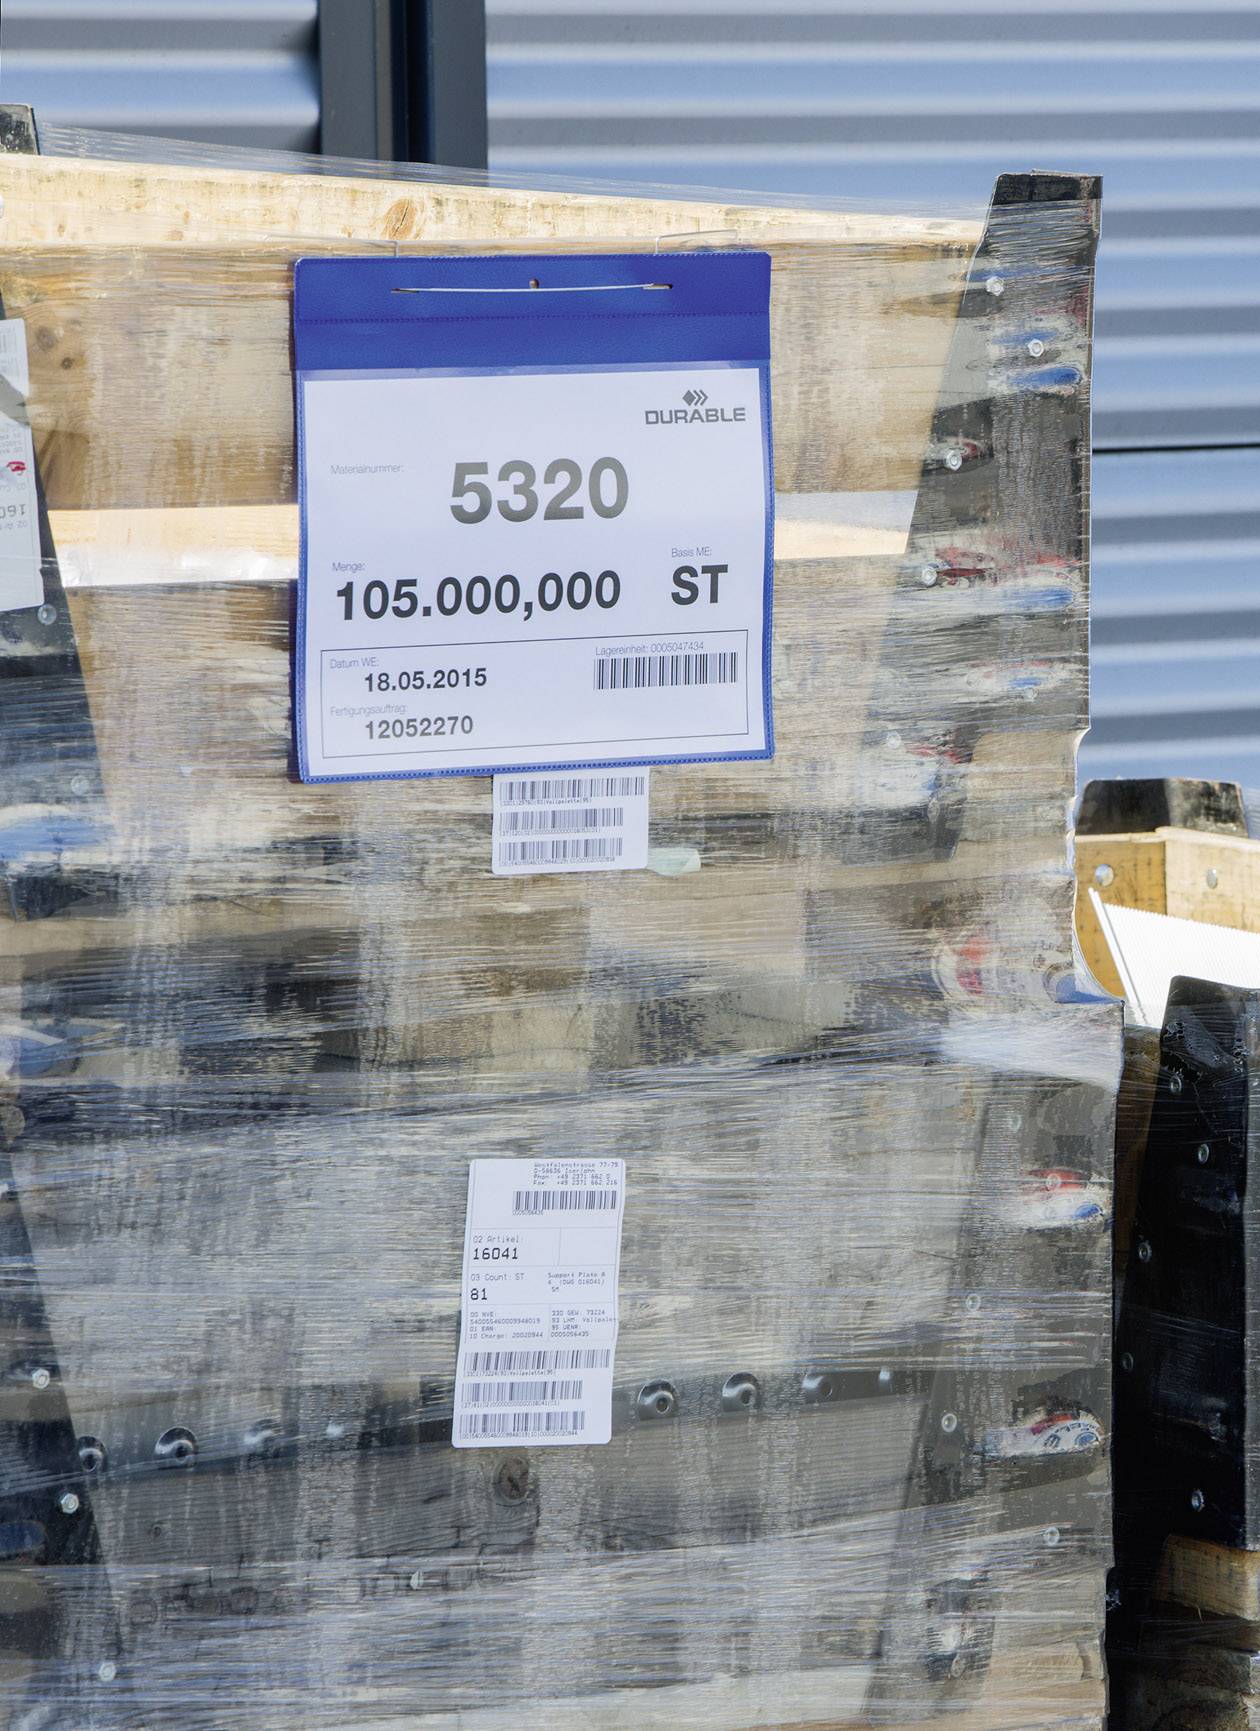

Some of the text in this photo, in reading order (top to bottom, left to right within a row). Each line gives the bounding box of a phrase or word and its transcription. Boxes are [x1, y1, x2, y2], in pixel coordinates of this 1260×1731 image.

[645, 407, 746, 424] DURABLE
[450, 456, 629, 524] 5320
[671, 546, 713, 558] Basis ME:
[332, 561, 365, 574] Menge:
[671, 564, 729, 606] ST
[337, 569, 621, 621] 105.000,000
[595, 641, 704, 657] Lagereinheit: 0005047434
[330, 657, 380, 669] Datum WE:
[364, 667, 488, 693] 18.05.2015
[365, 715, 474, 740] 12052270
[473, 1235, 483, 1244] 02
[473, 1247, 519, 1260] 16041
[515, 1272, 525, 1281] ST
[470, 1287, 488, 1301] 81
